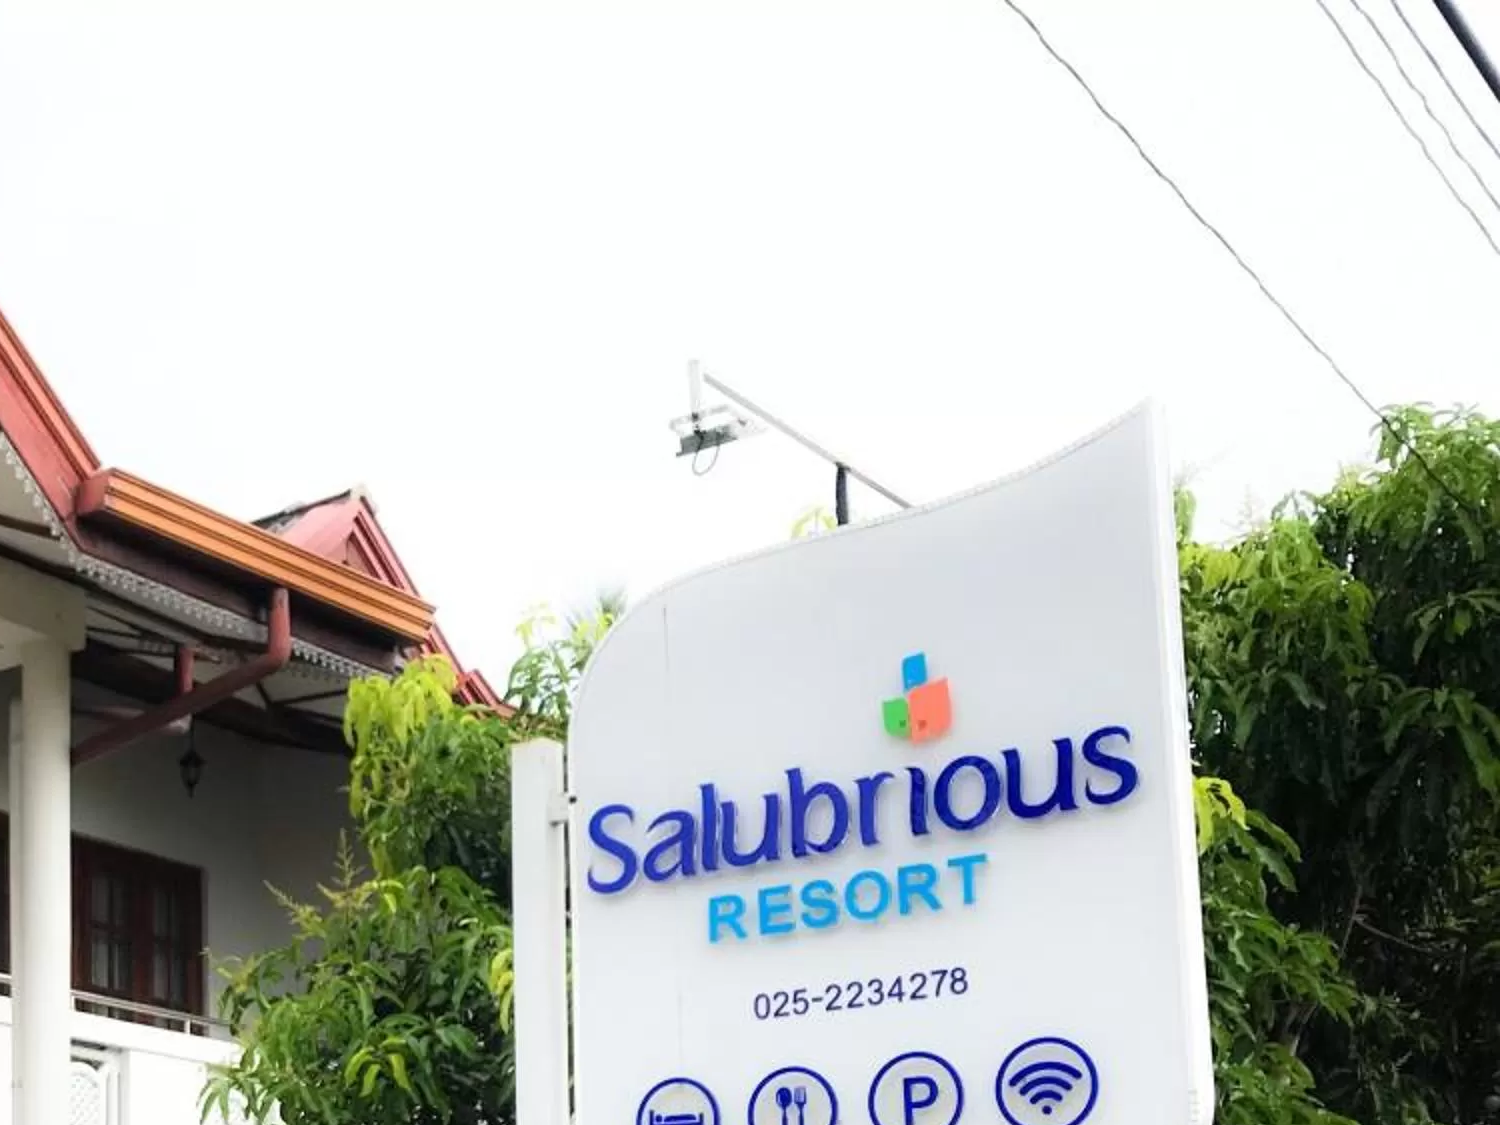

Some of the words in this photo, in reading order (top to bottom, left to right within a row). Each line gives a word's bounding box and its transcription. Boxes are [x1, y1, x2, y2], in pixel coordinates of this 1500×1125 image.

[587, 725, 1140, 894] Salubrious
[708, 852, 988, 943] RESORT
[753, 967, 969, 1021] 025-2234278
